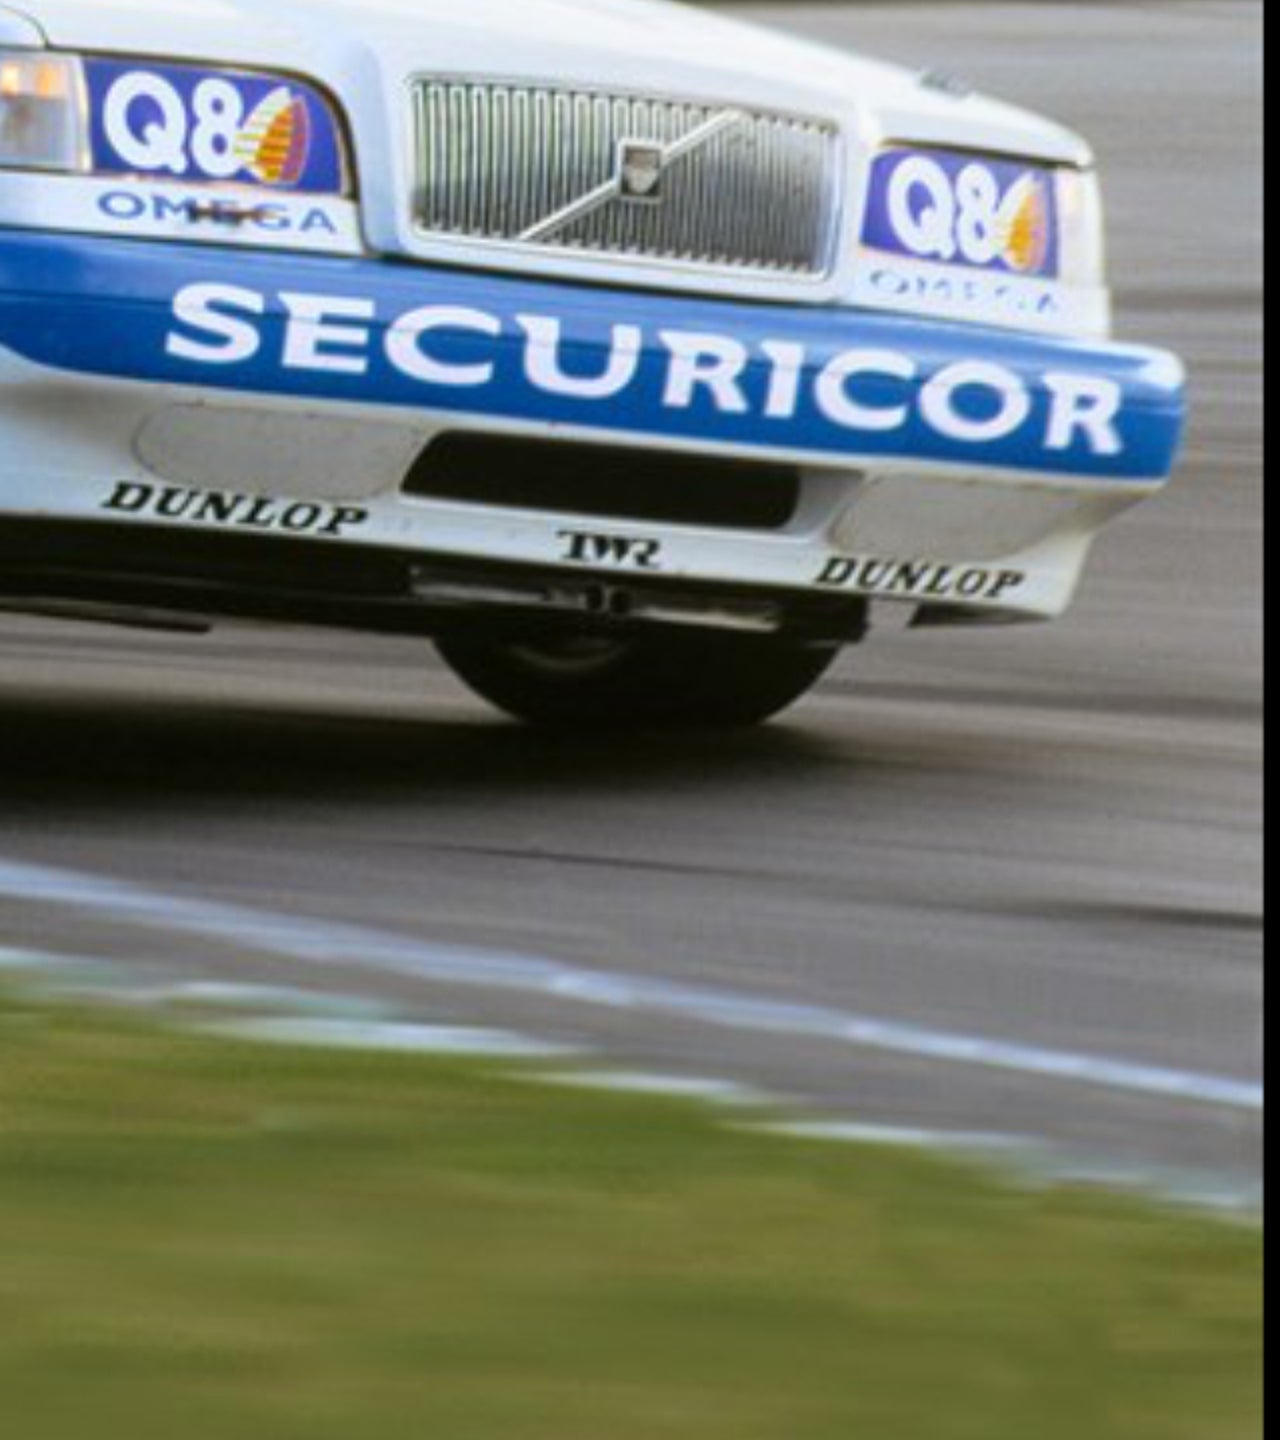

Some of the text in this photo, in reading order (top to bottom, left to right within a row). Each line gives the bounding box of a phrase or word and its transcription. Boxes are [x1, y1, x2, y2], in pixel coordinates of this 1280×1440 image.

[103, 70, 243, 178] Q8
[97, 190, 337, 234] OMEGA
[887, 155, 998, 263] Q8
[164, 282, 1124, 456] SECURICOR
[101, 481, 368, 535] DUNLOP
[557, 529, 661, 568] TWR
[816, 556, 1025, 599] DUNLOP
